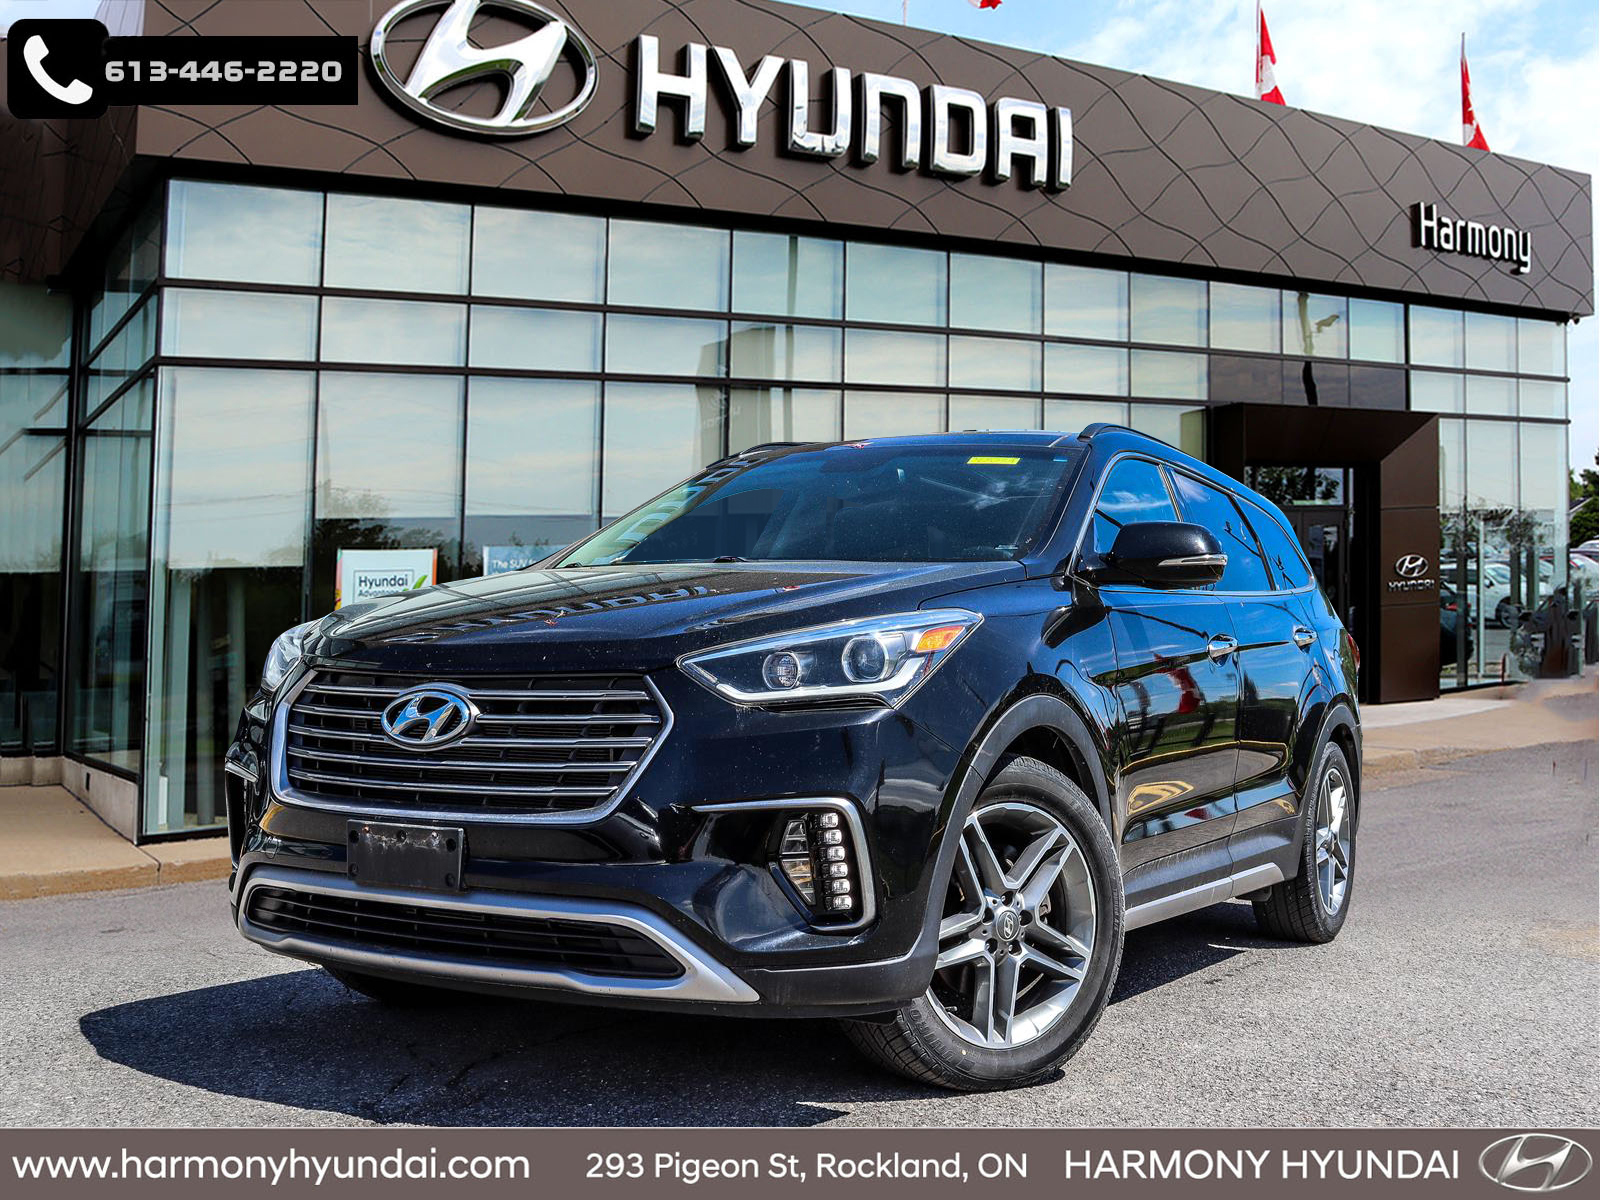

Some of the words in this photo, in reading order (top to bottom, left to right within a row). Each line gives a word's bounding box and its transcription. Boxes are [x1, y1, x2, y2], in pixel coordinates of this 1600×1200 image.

[634, 34, 1074, 191] HYUNDAI
[1419, 201, 1532, 274] Harmony
[493, 559, 509, 569] The
[358, 574, 408, 590] Hyundai
[1386, 579, 1435, 592] HYUNDAI
